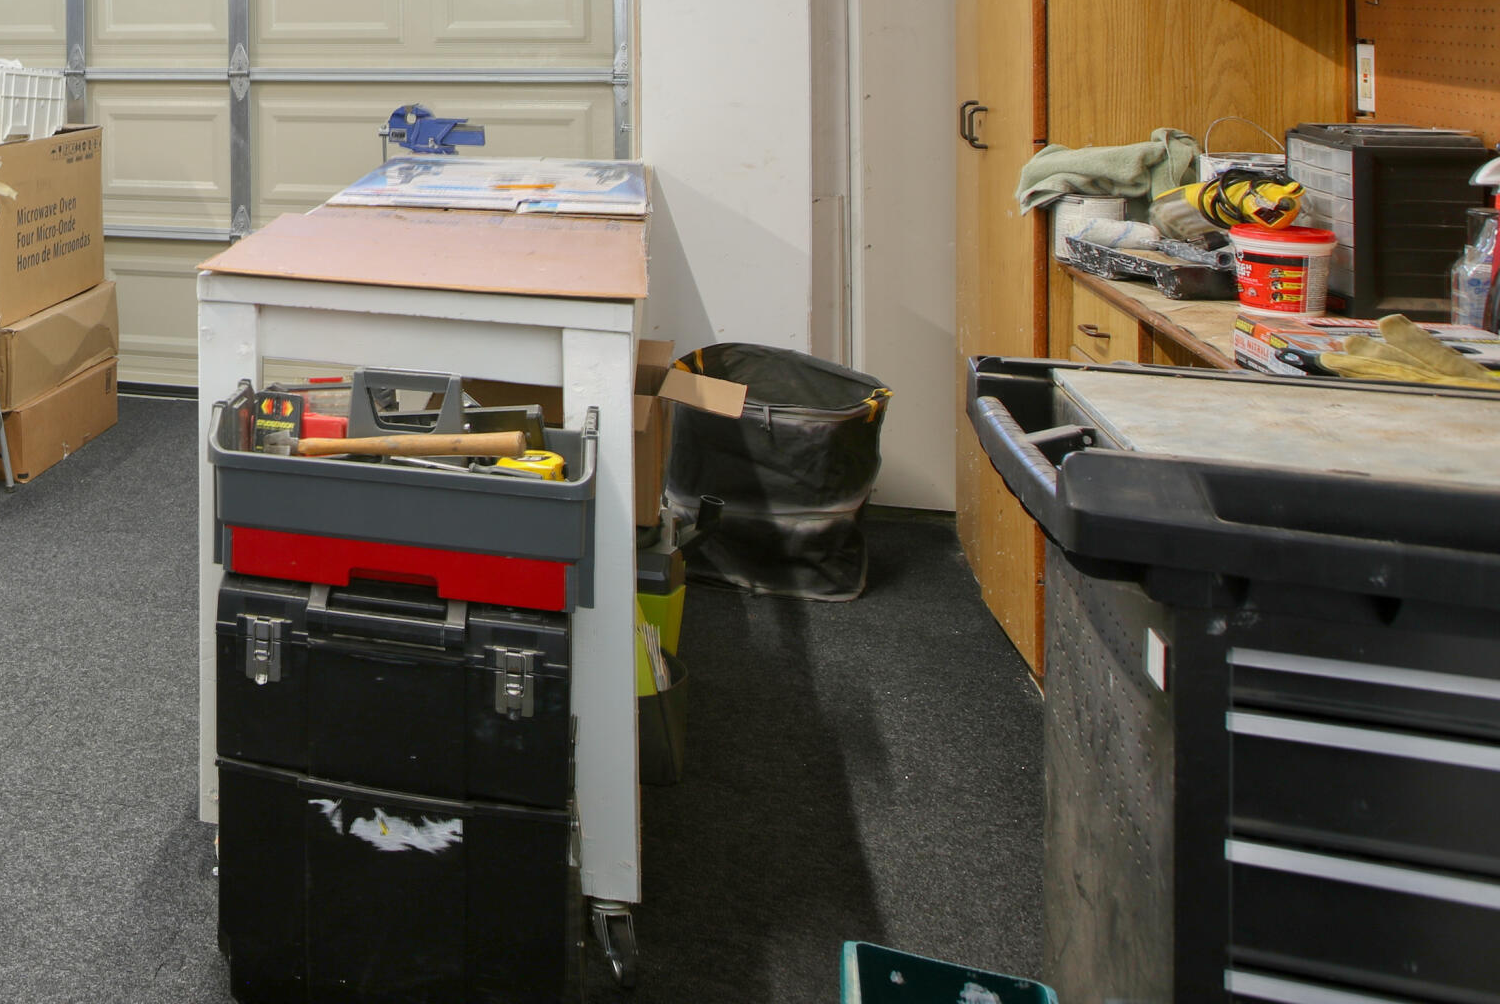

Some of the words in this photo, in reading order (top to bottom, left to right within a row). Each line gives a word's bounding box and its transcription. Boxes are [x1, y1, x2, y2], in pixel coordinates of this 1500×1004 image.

[17, 203, 57, 226] Microwave
[59, 197, 77, 214] Oven
[17, 231, 34, 249] Four
[36, 216, 76, 242] Micro-Onde
[17, 253, 40, 272] Horno
[41, 245, 51, 263] de
[53, 231, 91, 258] Microondas
